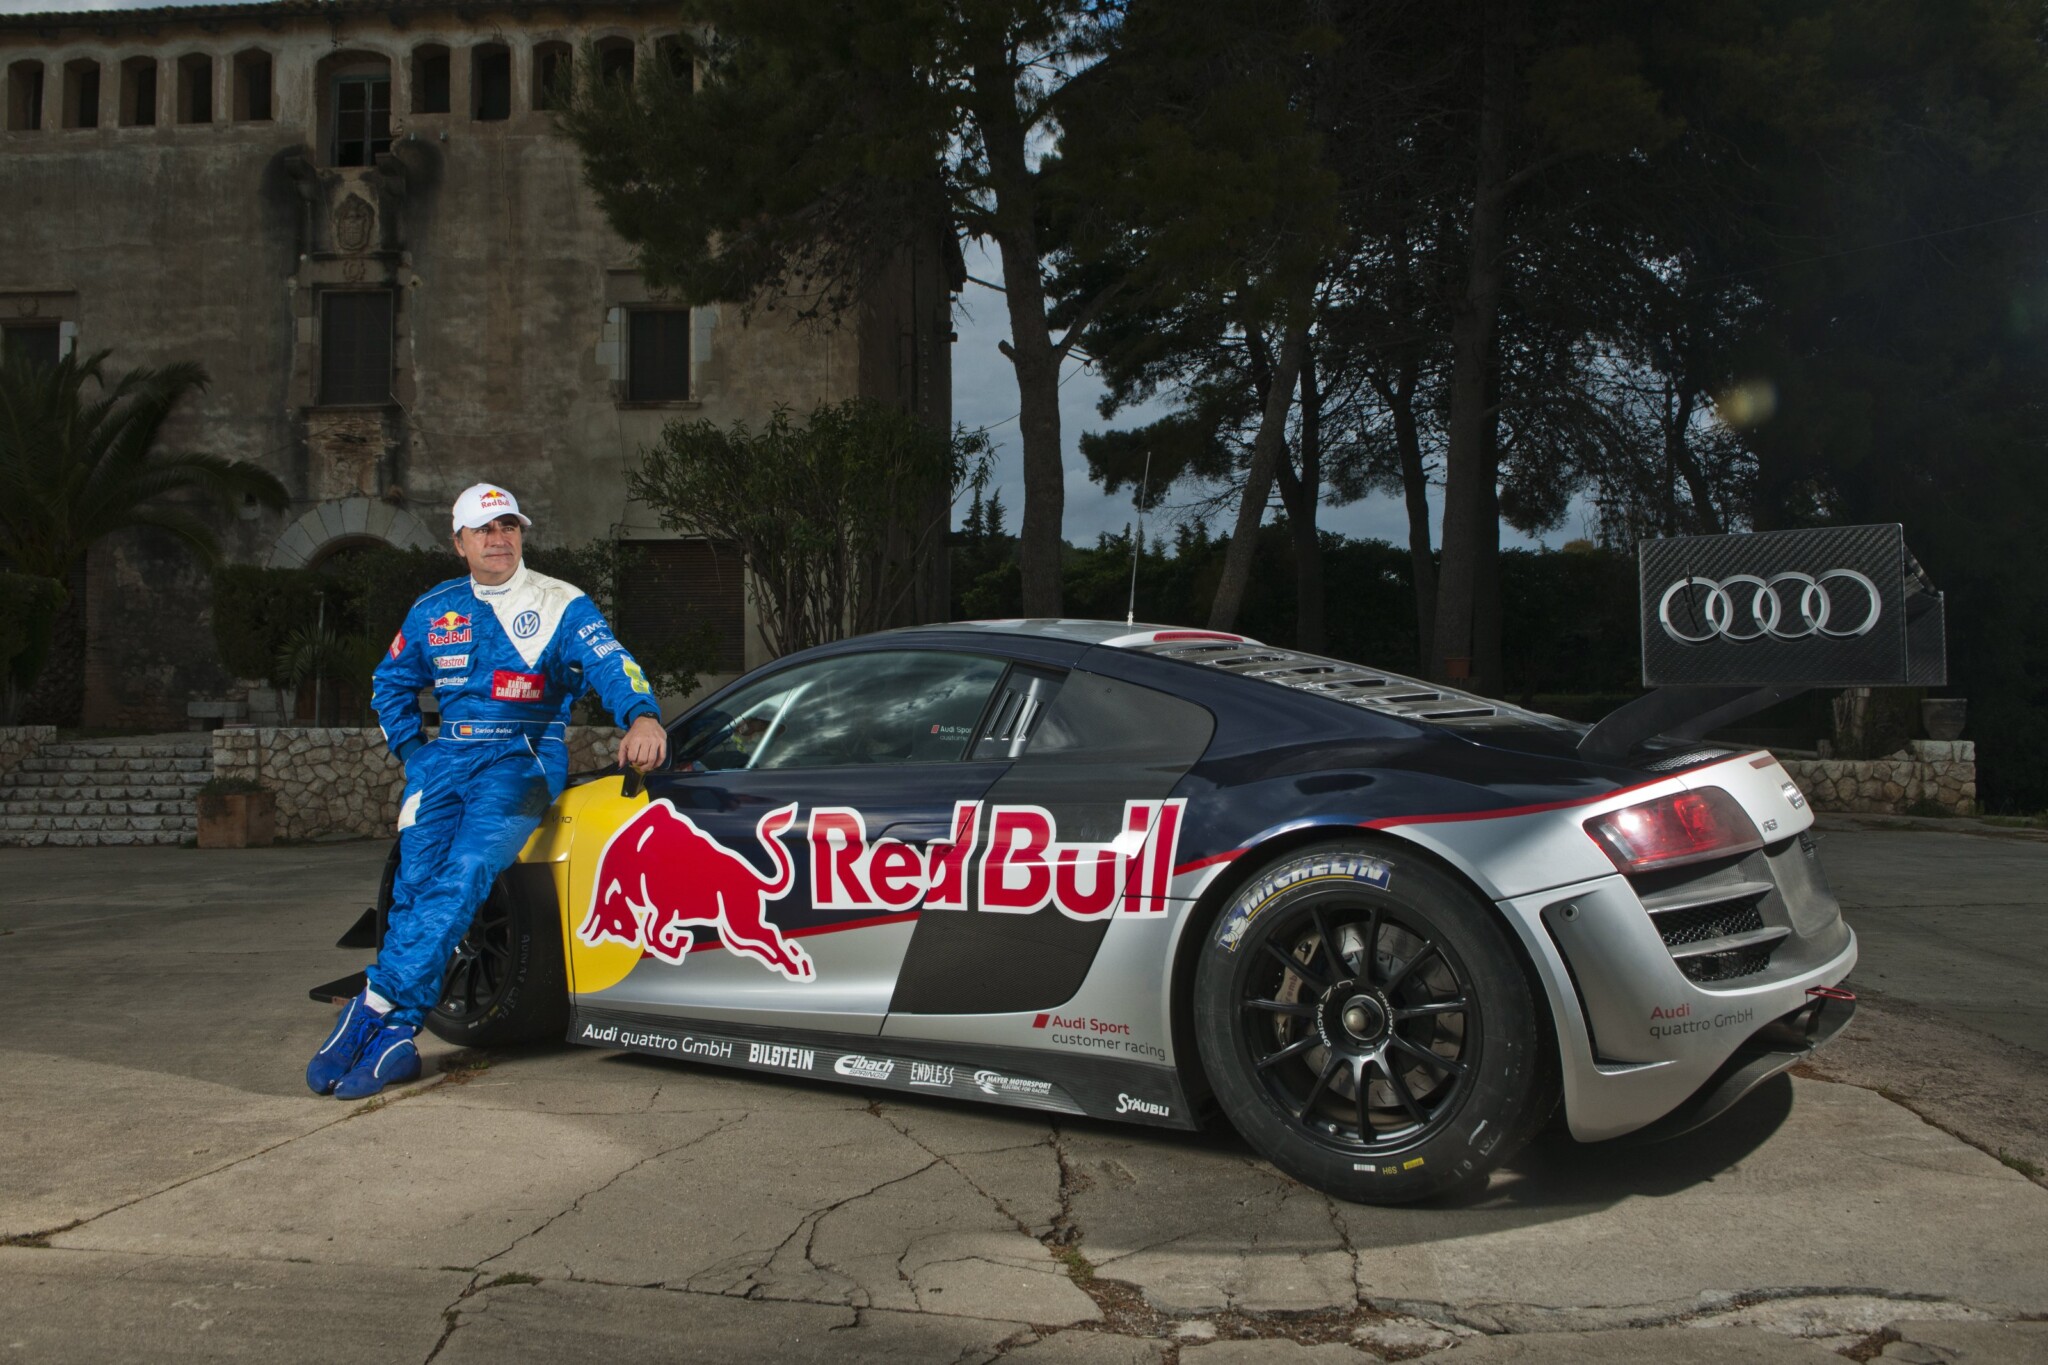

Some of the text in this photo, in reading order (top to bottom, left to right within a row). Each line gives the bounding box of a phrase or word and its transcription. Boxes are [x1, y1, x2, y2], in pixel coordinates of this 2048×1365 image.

[481, 499, 511, 509] Red Bull
[428, 628, 472, 646] Red Bull
[440, 656, 466, 668] Castrol
[496, 687, 541, 698] CARLOS SAINZ
[940, 725, 972, 735] Audi Spor
[808, 798, 1188, 921] Red Bull
[1241, 858, 1385, 916] MICHELIN
[1650, 1003, 1690, 1020] Audi
[1052, 1015, 1130, 1035] Audi Sport
[1316, 1003, 1332, 1048] RACING
[1649, 1007, 1753, 1040] quattro GmbH
[582, 1023, 733, 1059] Audi quattro GmbH
[1052, 1033, 1166, 1062] customer racing
[748, 1043, 815, 1071] BILSTEIN
[834, 1054, 895, 1075] Eibach
[849, 1069, 887, 1079] SPRINGS
[910, 1062, 954, 1085] ENDLESS
[986, 1075, 1052, 1089] MAYER MOTORSPORT
[1116, 1093, 1169, 1117] STÄUBLI
